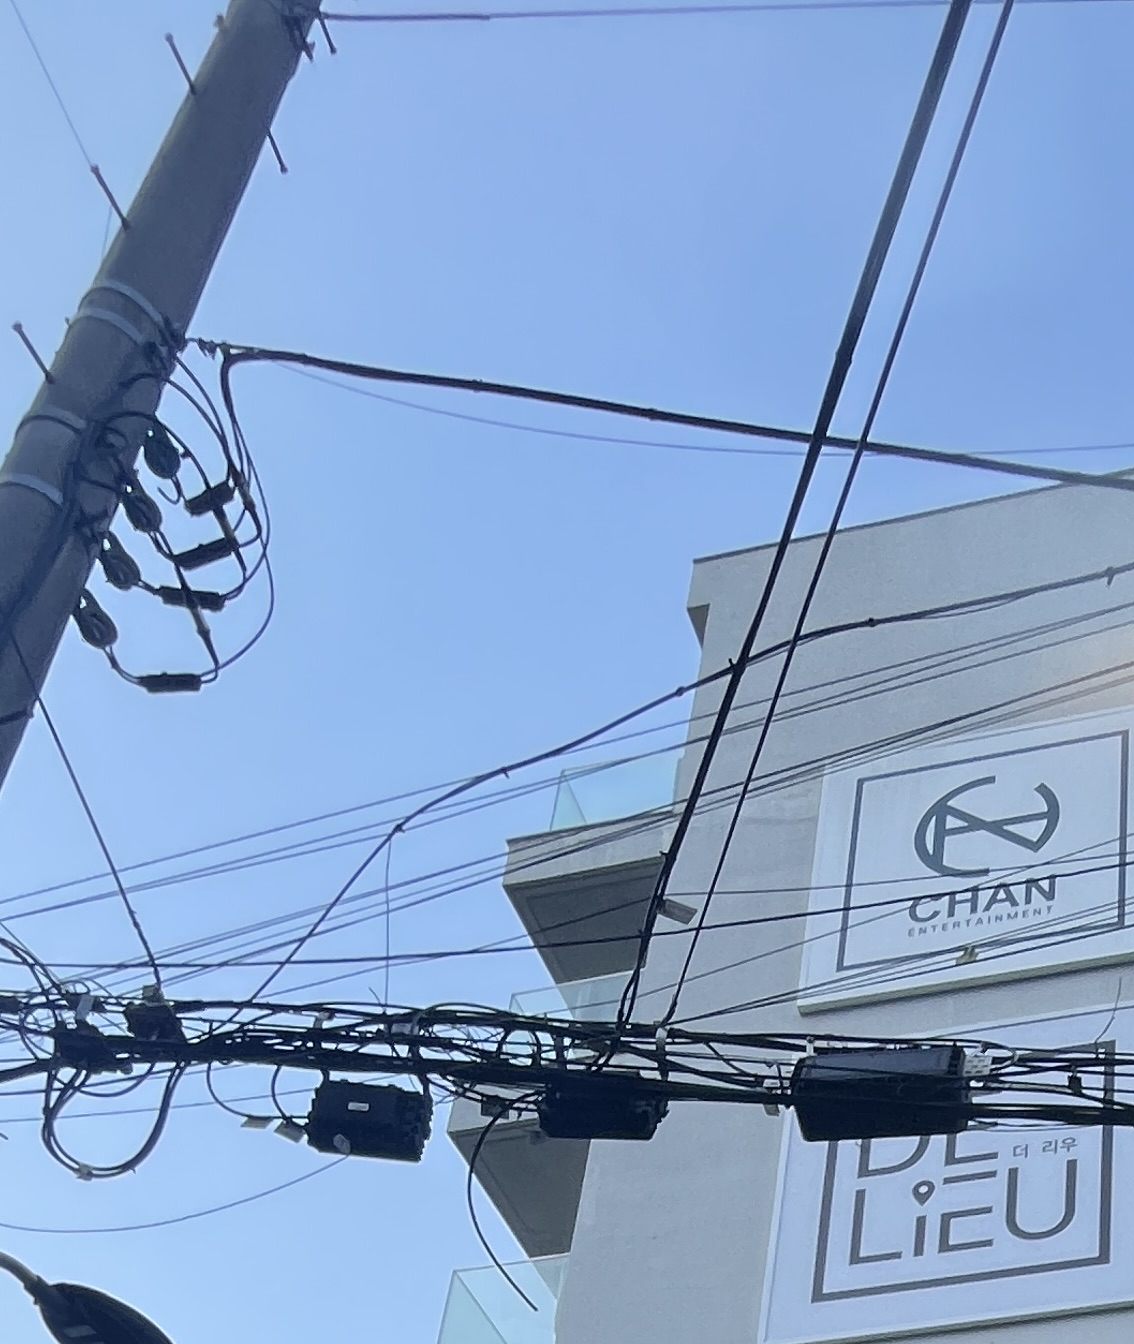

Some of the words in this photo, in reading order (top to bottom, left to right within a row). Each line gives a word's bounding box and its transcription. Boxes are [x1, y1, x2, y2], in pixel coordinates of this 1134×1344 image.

[908, 874, 1057, 923] CHAN
[907, 904, 1054, 938] ENTERTAINMENT
[1012, 1143, 1029, 1159] 더
[1042, 1136, 1078, 1155] 리우
